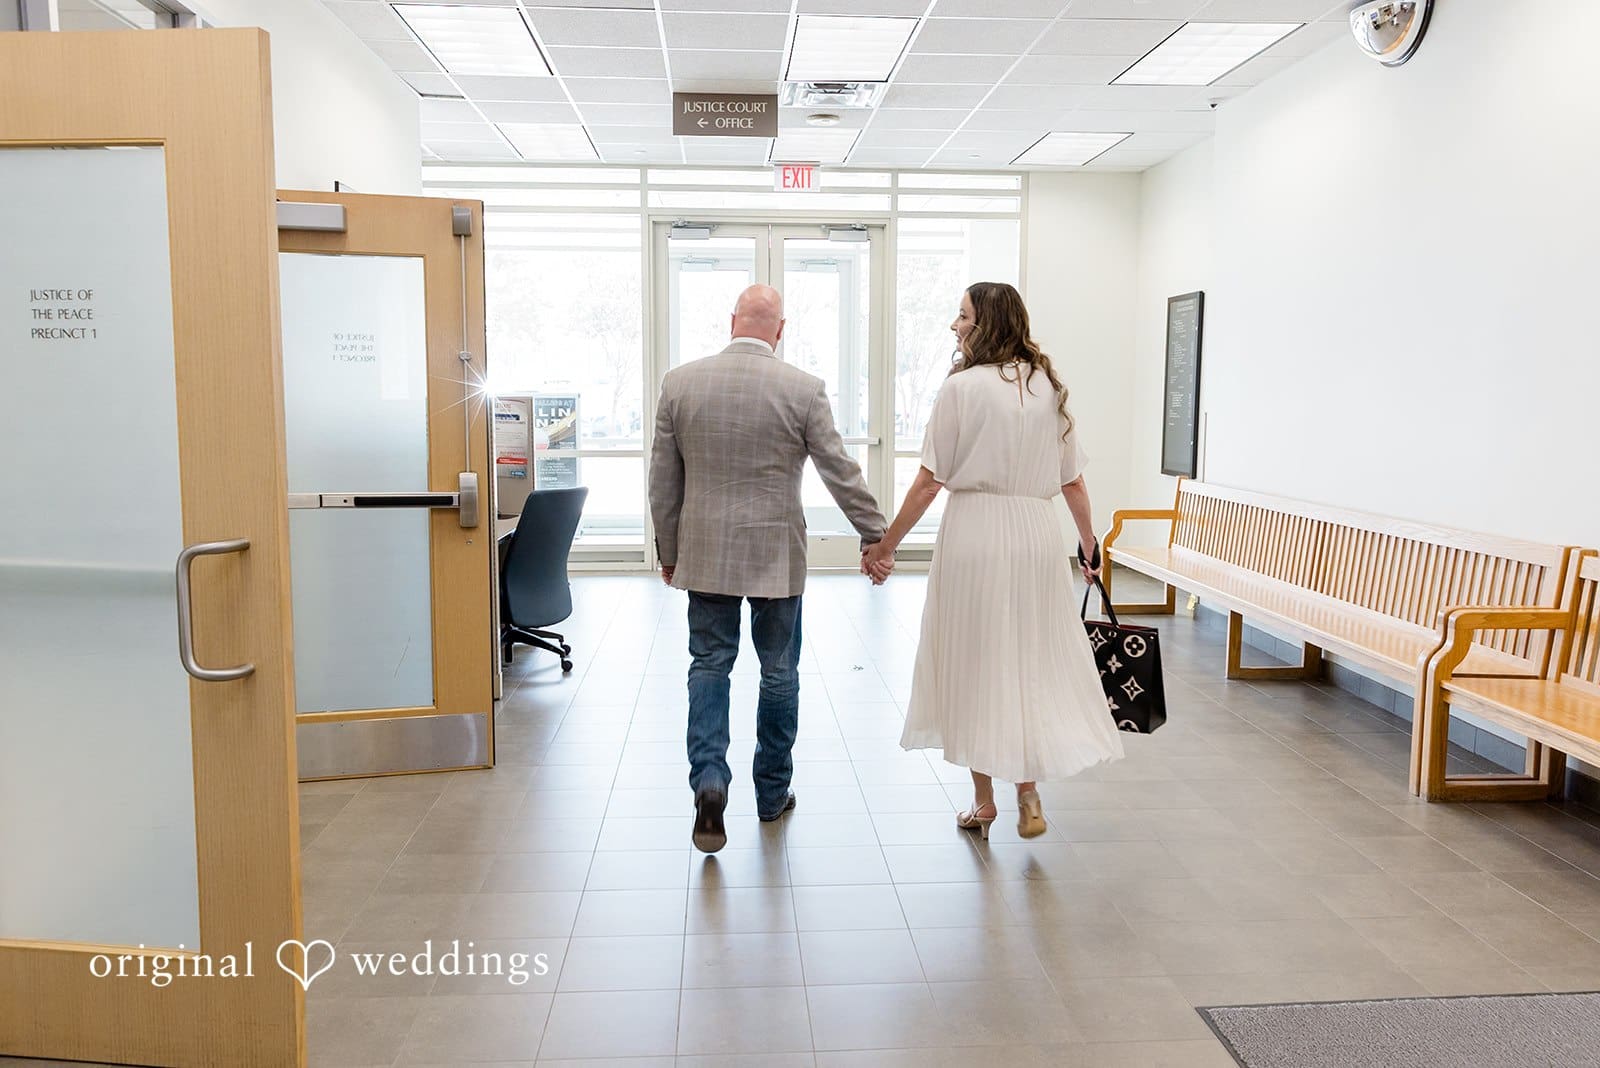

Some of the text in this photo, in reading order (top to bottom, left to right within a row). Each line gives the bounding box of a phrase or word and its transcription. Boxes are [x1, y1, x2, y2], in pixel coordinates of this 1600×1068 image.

[683, 101, 768, 114] JUSTICE COURT
[715, 117, 754, 129] OFFICE
[782, 167, 814, 189] EXIT
[30, 289, 94, 302] JUSTICE OF
[31, 308, 94, 320] THE PEACE
[31, 327, 97, 339] PRECINCT 1
[536, 407, 571, 417] LIN
